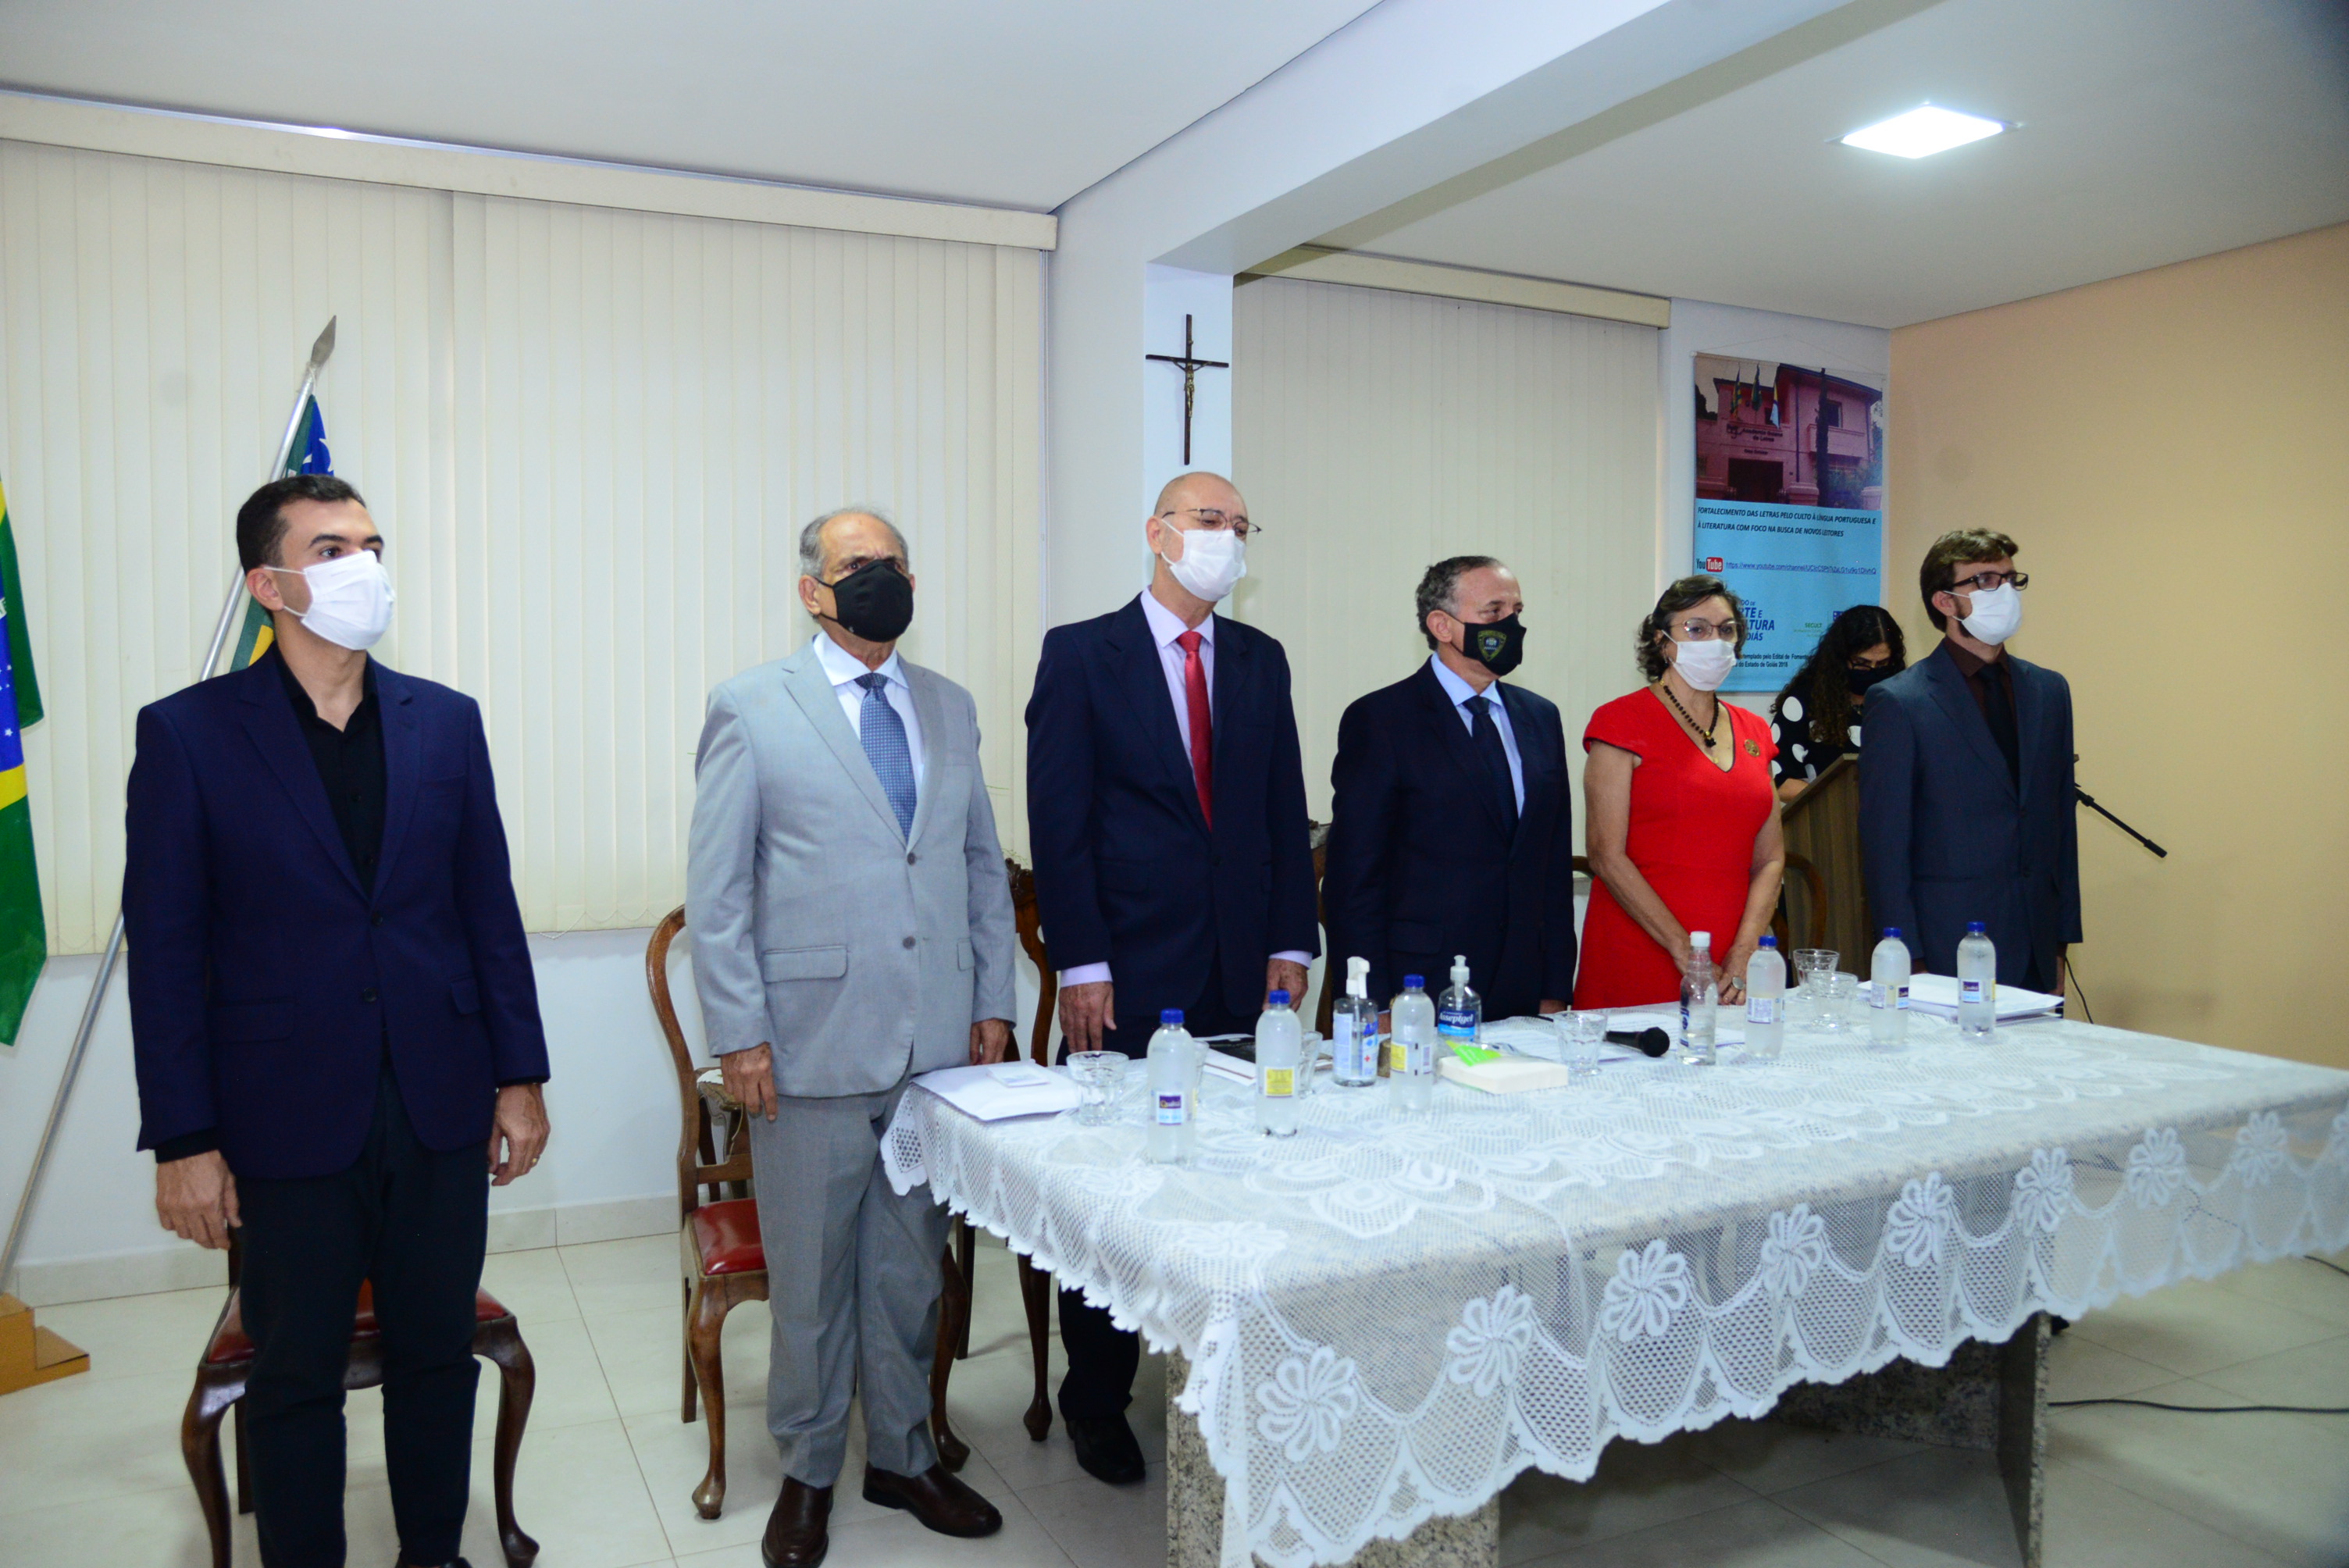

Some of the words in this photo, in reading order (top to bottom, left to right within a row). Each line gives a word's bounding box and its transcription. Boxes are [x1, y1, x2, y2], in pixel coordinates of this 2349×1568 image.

[1698, 507, 1746, 516] FORTALECIMENTO
[1816, 514, 1834, 522] LÍNGUA
[1834, 515, 1871, 524] PORTUGUESA
[1702, 522, 1735, 531] LITERATURA
[1822, 529, 1844, 537] LEITORES
[1758, 610, 1763, 618] E
